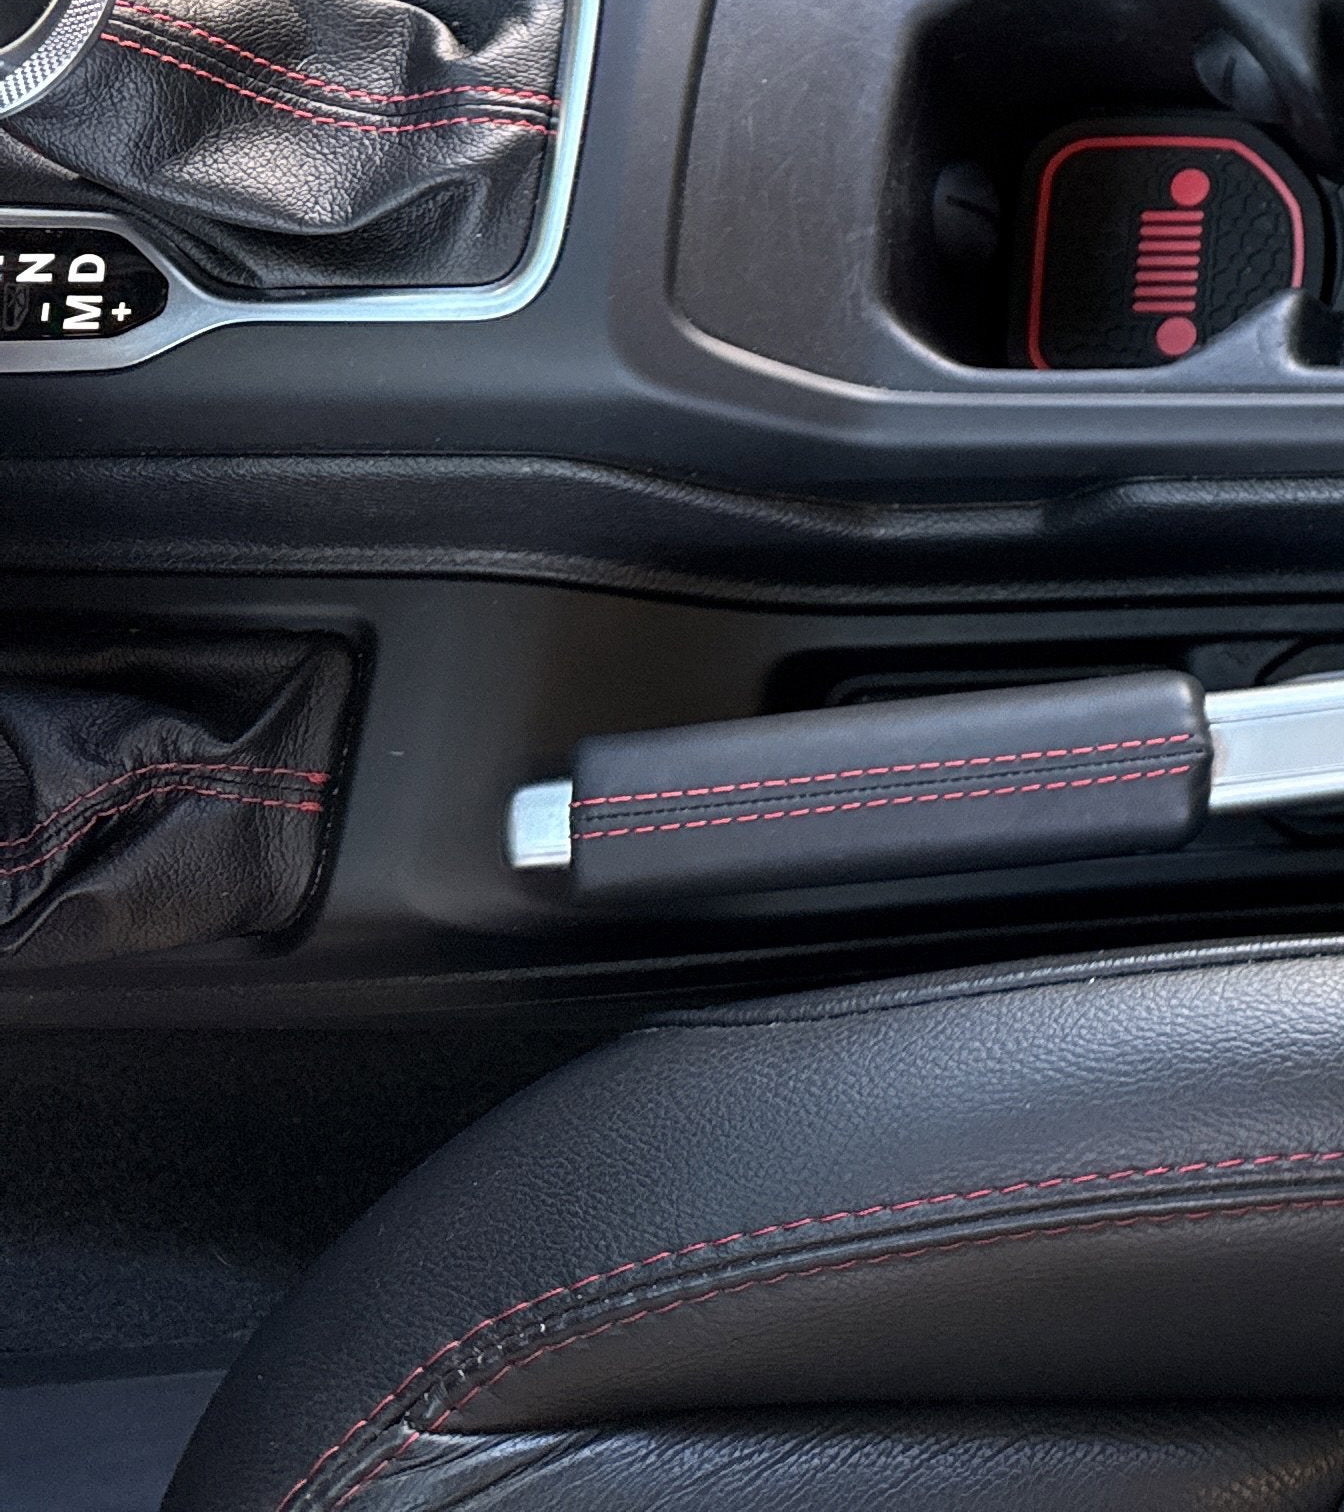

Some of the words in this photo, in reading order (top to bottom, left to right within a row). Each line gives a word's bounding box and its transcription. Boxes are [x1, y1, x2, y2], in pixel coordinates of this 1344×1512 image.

[16, 253, 56, 283] N
[68, 253, 105, 283] D
[62, 295, 103, 330] M
